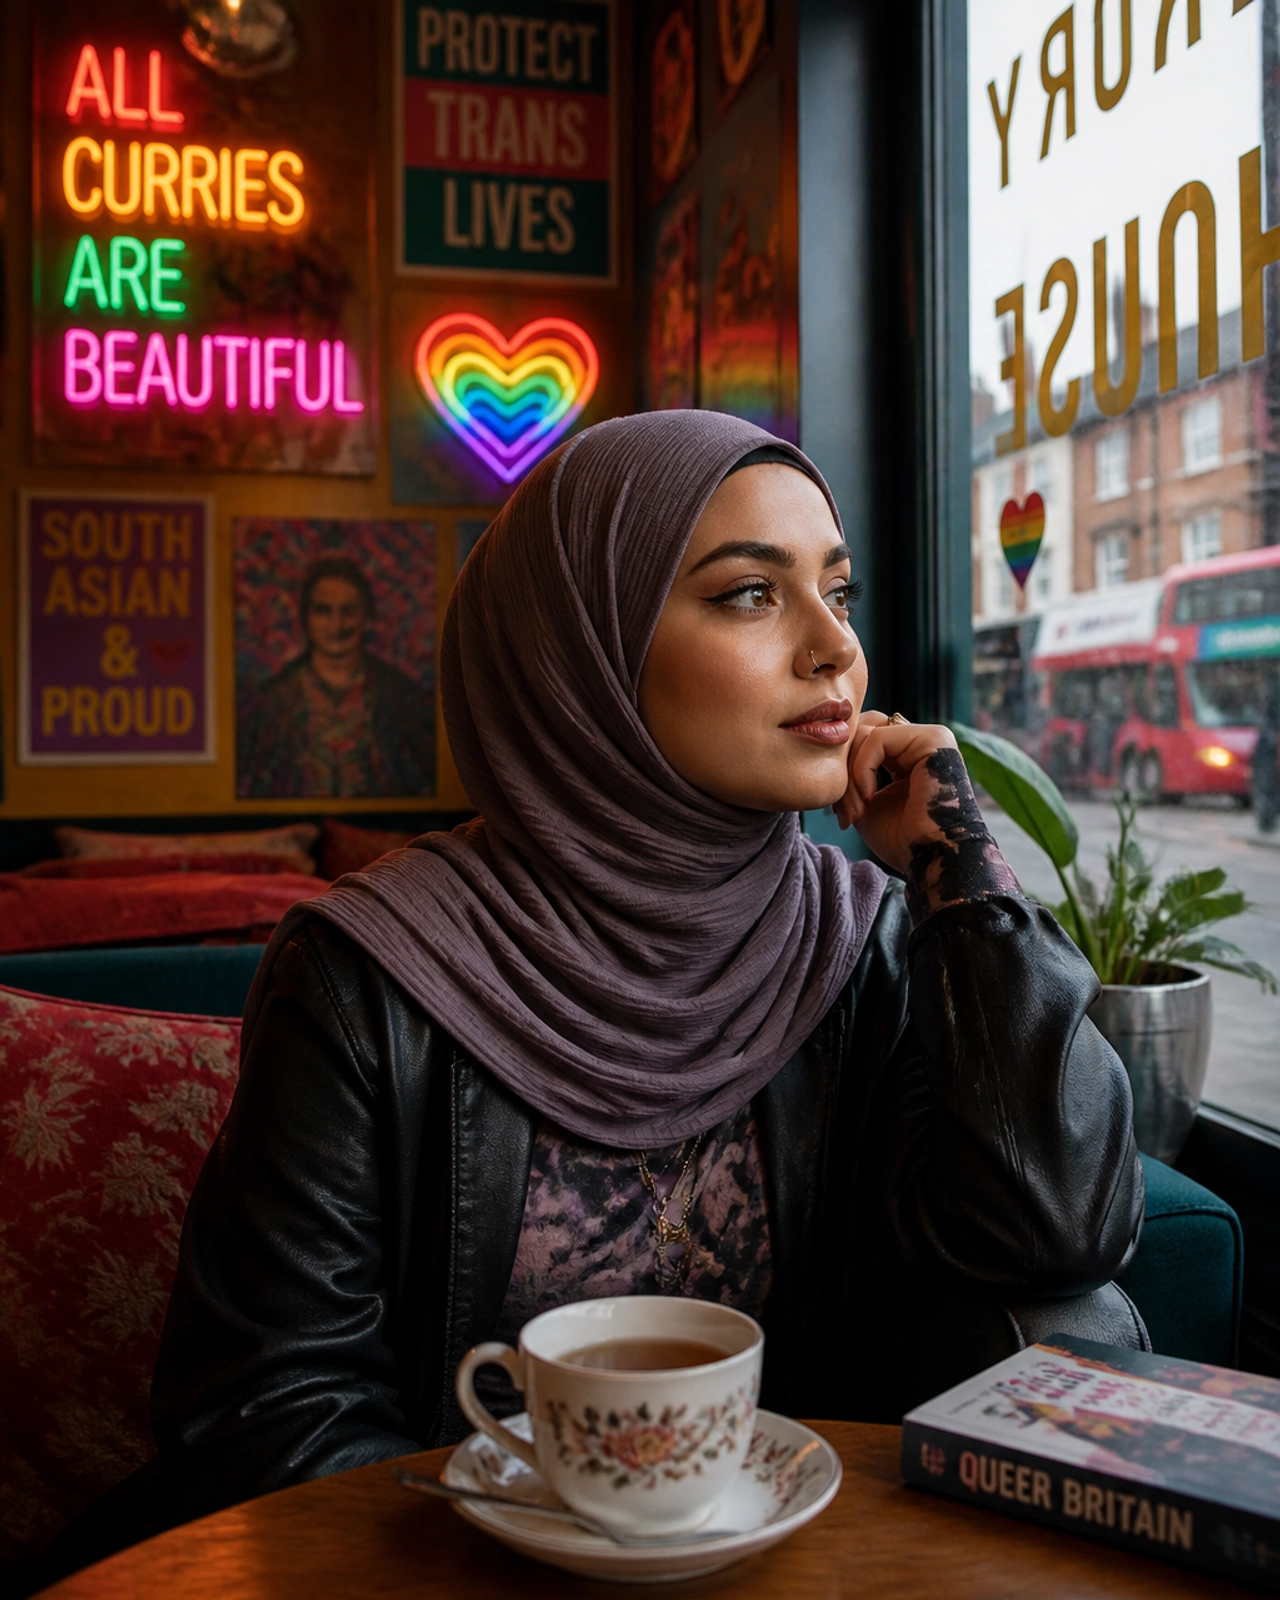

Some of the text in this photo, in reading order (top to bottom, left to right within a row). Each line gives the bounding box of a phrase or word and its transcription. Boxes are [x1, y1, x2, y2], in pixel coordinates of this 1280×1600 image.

[66, 44, 185, 124] ALL
[418, 8, 597, 83] PROTECT
[428, 89, 586, 168] TRANS
[62, 136, 305, 226] CURRIES
[443, 178, 575, 255] LIVES
[63, 234, 186, 313] ARE
[64, 328, 364, 413] BEAUTIFUL
[41, 511, 193, 561] SOUTH
[44, 567, 192, 618] ASIAN
[102, 626, 138, 679] &
[41, 686, 196, 737] PROUD
[959, 1451, 1052, 1510] QUEER
[1062, 1477, 1194, 1550] BRITAIN
